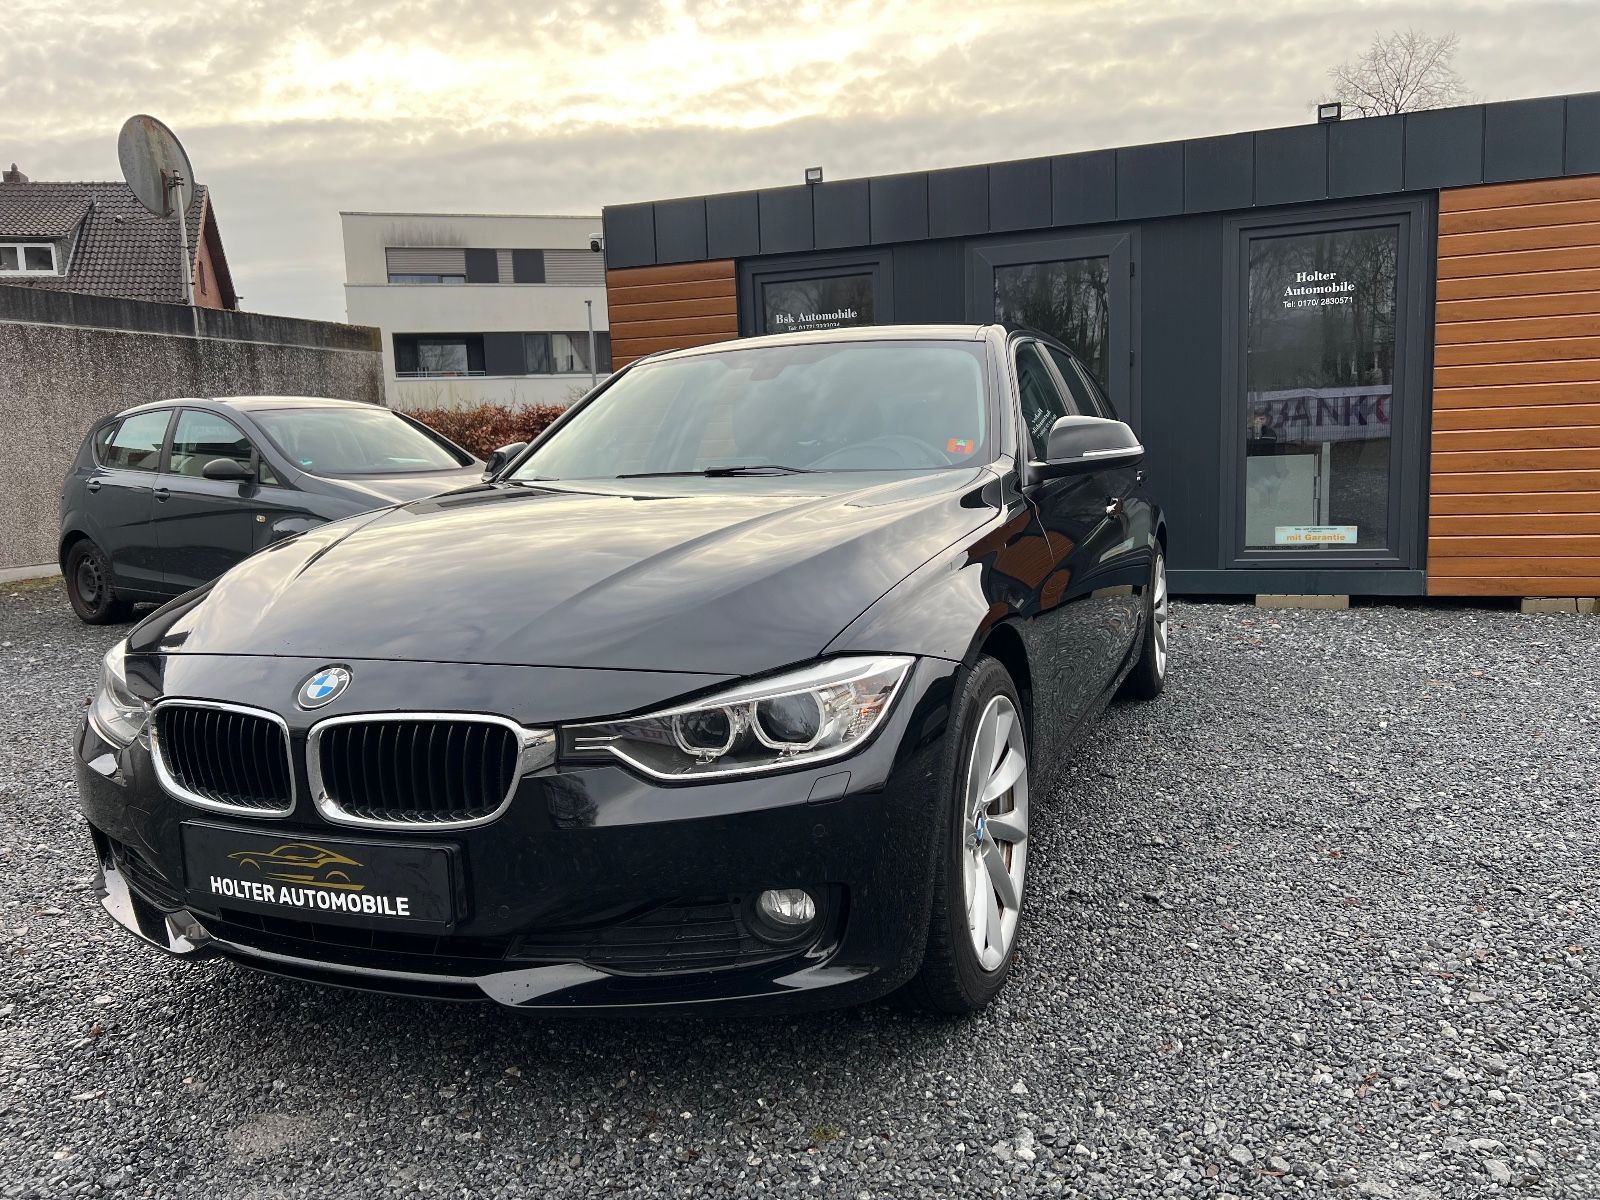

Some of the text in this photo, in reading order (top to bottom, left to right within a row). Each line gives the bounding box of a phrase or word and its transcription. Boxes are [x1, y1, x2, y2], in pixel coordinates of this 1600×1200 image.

[1295, 270, 1337, 283] Holter
[1284, 281, 1355, 297] Automobile
[1282, 301, 1296, 309] Tel:
[1320, 296, 1353, 306] 2830571
[776, 308, 858, 324] Bsk Automobile
[1286, 533, 1346, 541] mit Garantie
[210, 875, 410, 915] HOLTER AUTOMOBILE
